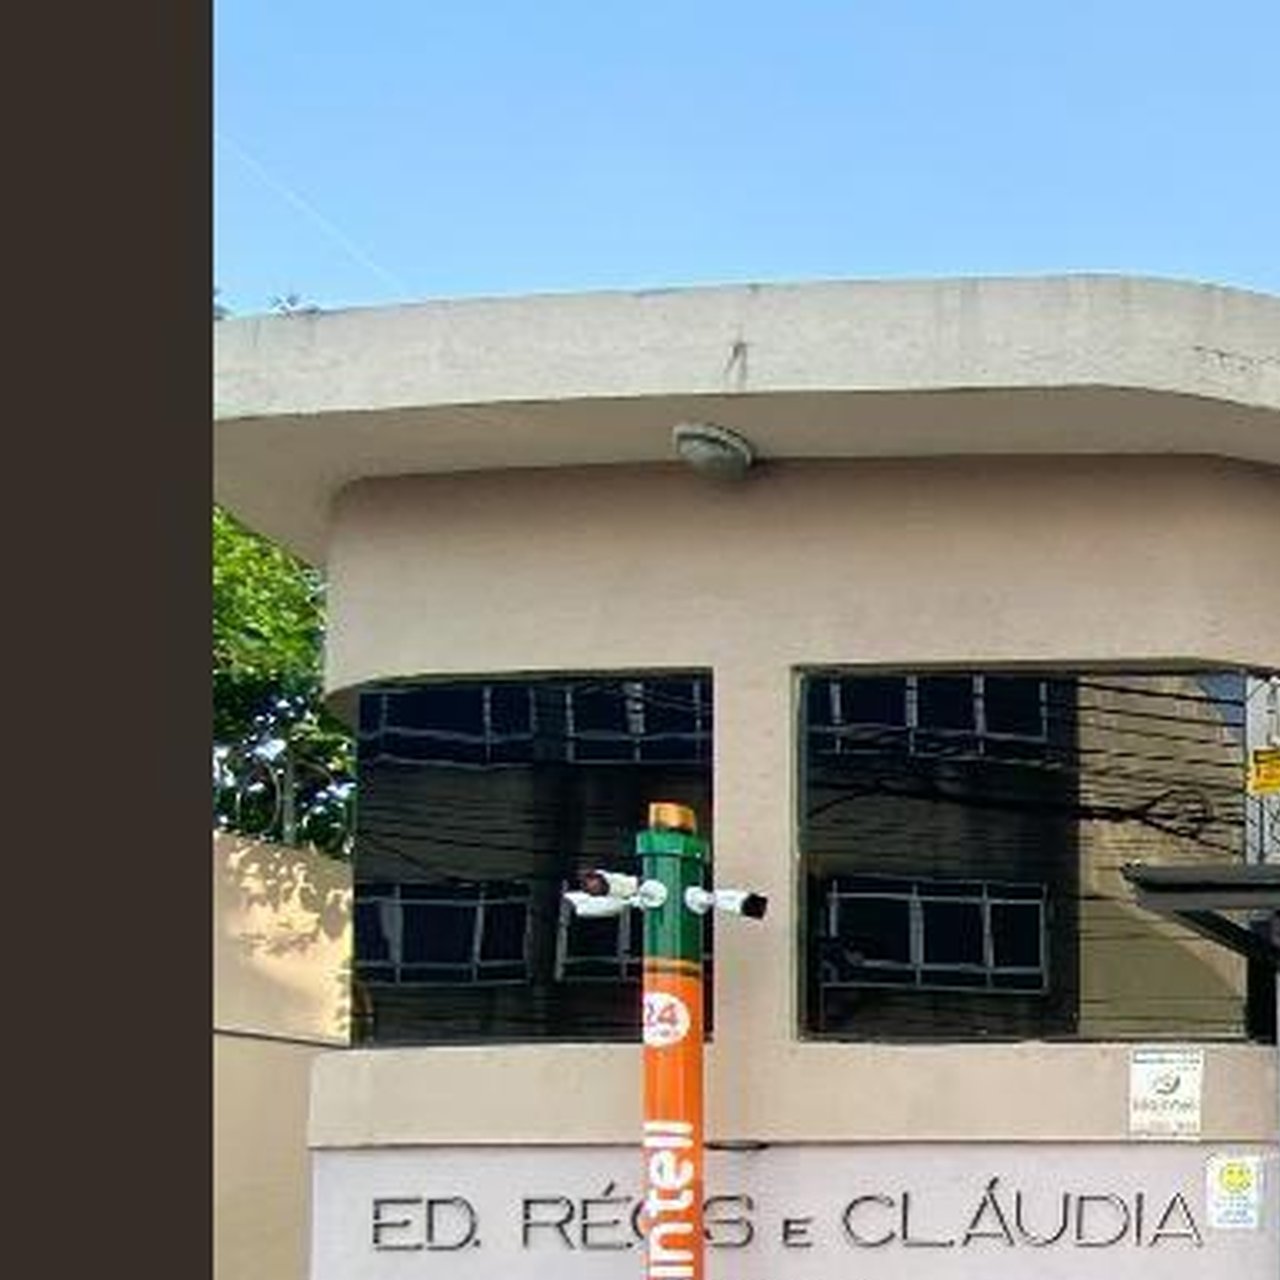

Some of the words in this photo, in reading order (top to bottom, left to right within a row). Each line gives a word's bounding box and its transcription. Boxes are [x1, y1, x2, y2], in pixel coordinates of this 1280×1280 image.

[371, 1196, 481, 1251] ED.
[523, 1182, 754, 1250] RÉS
[842, 1178, 1204, 1248] CLÁUDIA
